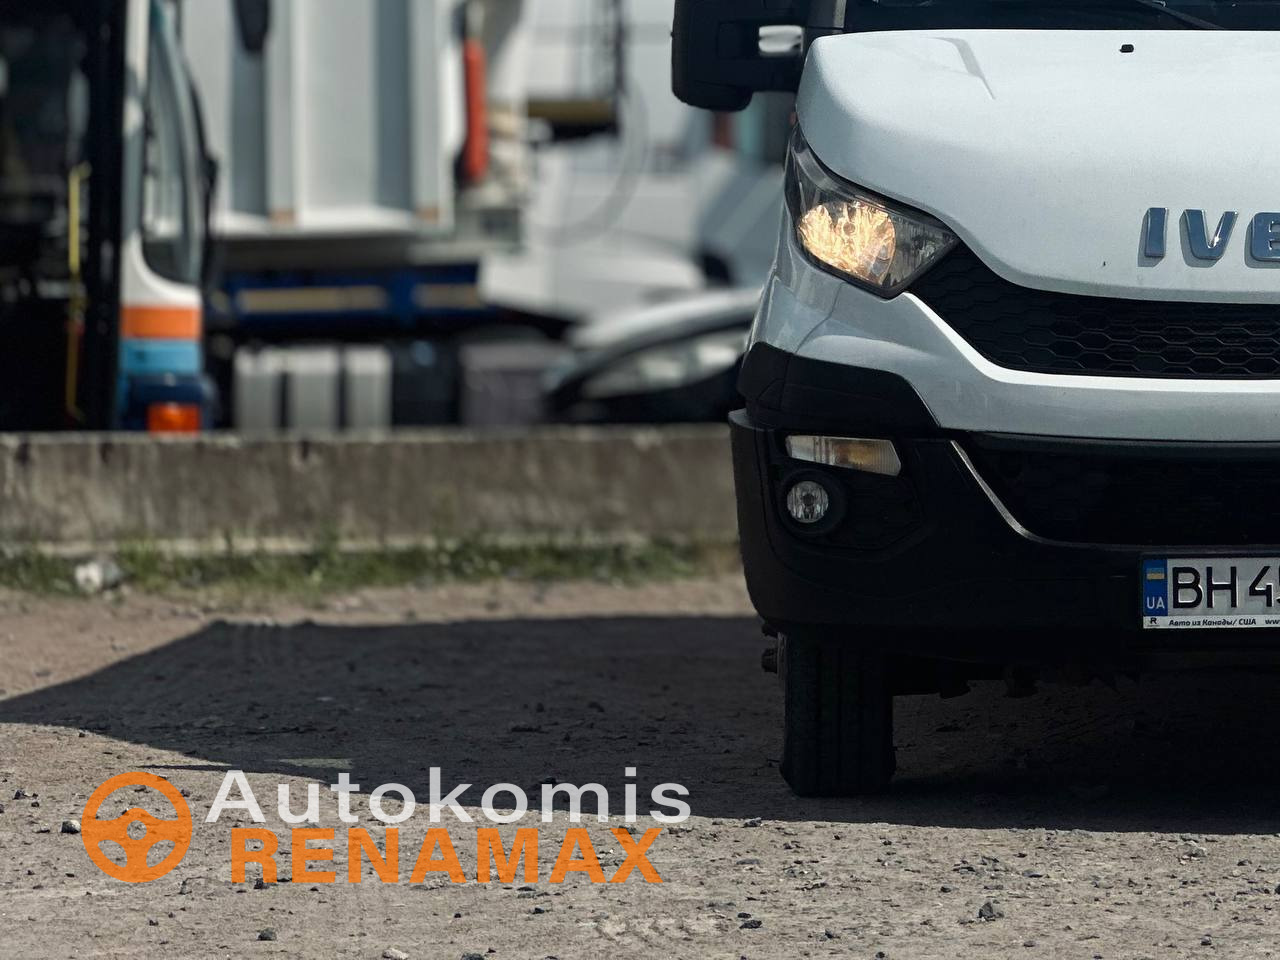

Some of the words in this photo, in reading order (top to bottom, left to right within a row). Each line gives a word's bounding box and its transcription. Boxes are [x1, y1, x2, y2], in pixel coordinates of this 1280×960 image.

[1172, 566, 1238, 609] BH
[1146, 597, 1165, 609] UA
[1169, 619, 1191, 627] Авто
[1238, 618, 1257, 626] США
